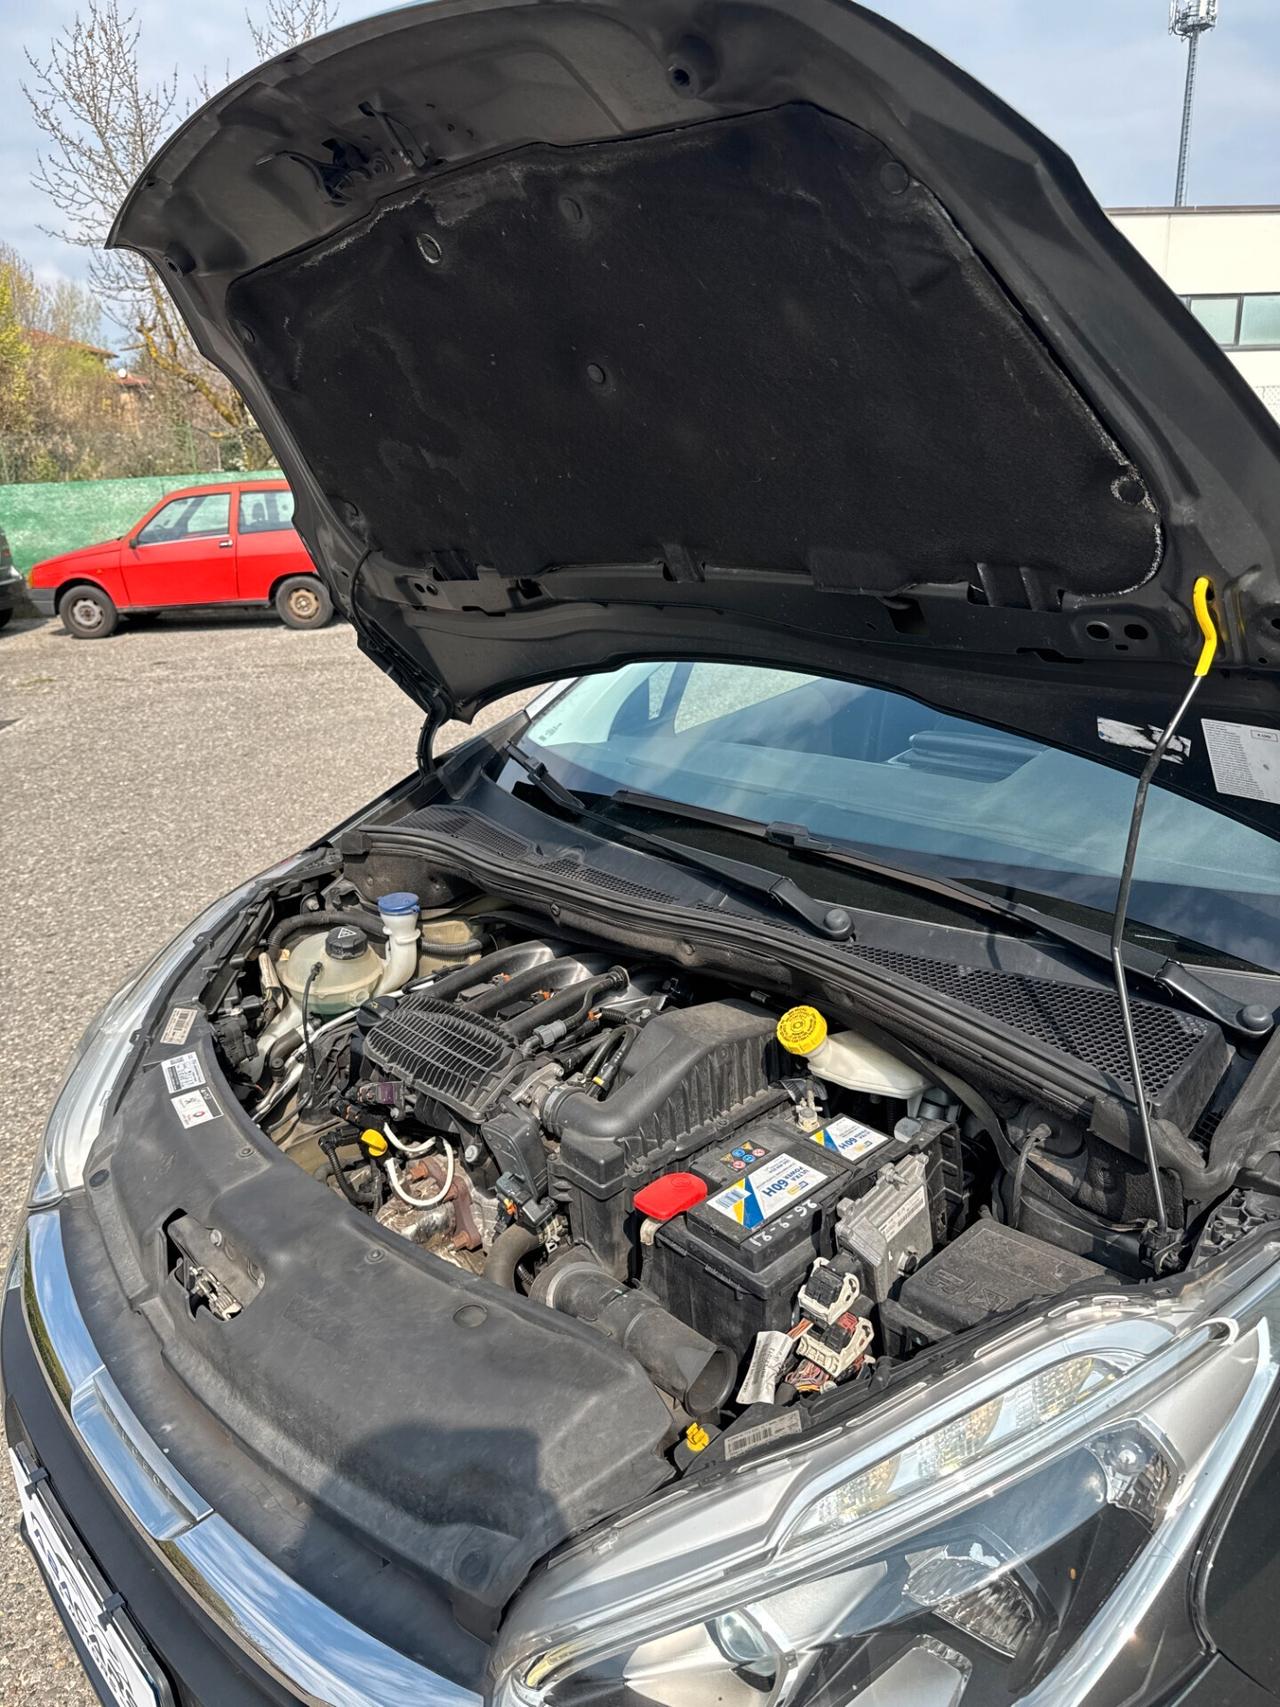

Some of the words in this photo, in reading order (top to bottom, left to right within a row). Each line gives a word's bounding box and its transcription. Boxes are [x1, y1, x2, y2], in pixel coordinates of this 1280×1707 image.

[838, 1137, 858, 1150] 60H
[783, 1166, 804, 1180] POWER
[790, 1169, 809, 1181] ULTRA
[762, 1179, 789, 1197] 60H
